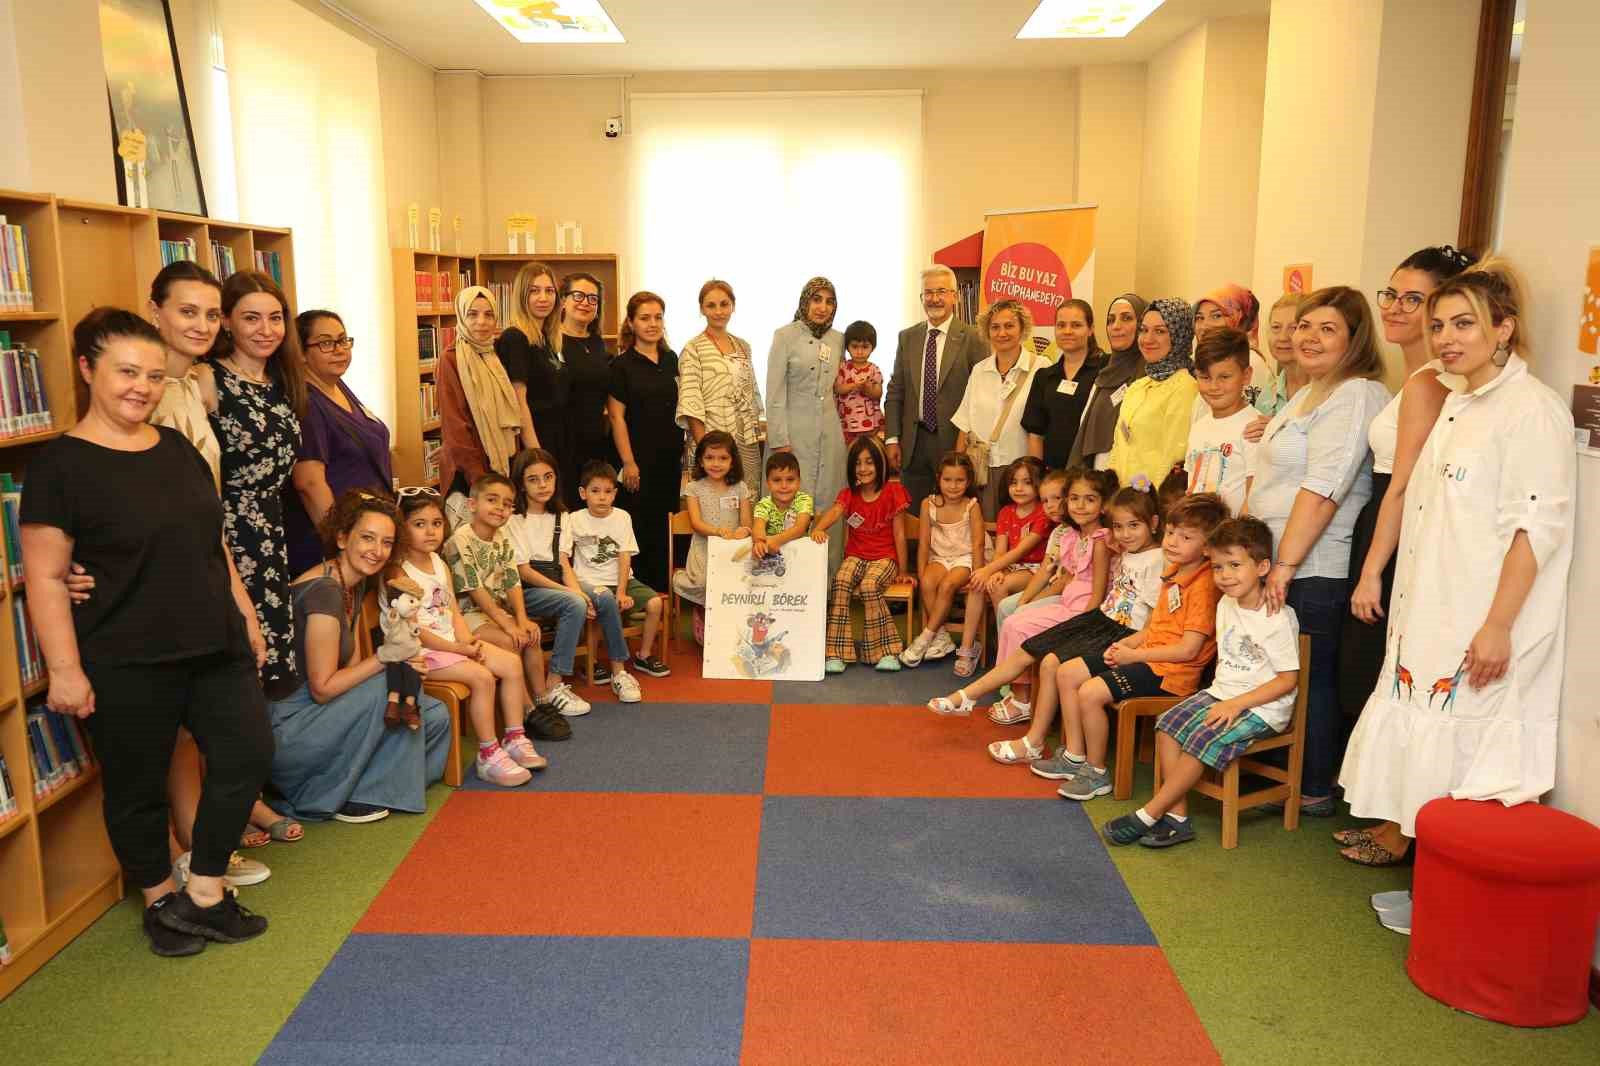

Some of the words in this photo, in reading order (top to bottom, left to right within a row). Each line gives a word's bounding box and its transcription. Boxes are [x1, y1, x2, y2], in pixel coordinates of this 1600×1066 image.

[1000, 261, 1018, 279] BİZ
[1019, 266, 1035, 282] BU
[1036, 270, 1058, 288] YAZ
[772, 593, 808, 606] BÖREK
